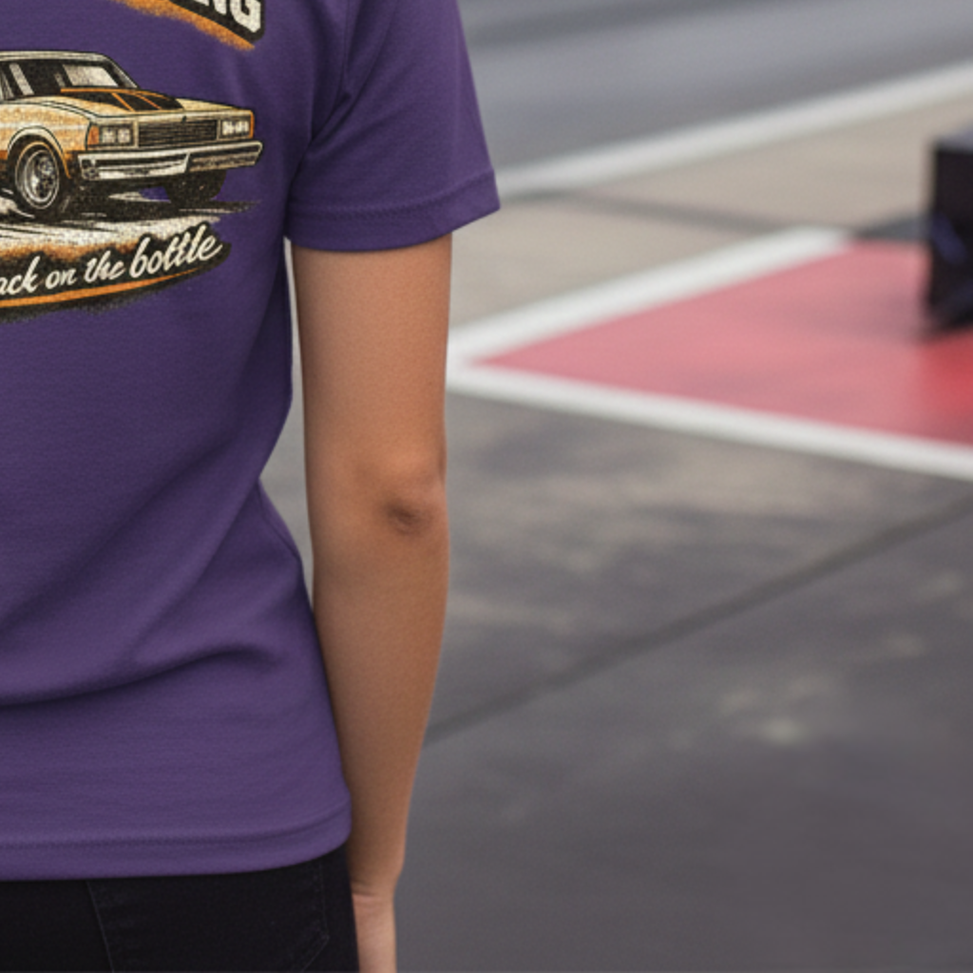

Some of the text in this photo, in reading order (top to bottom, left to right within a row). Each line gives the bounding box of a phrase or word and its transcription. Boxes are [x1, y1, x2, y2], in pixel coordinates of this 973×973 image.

[45, 268, 78, 290] on
[84, 250, 127, 284] the
[129, 224, 223, 279] bottle
